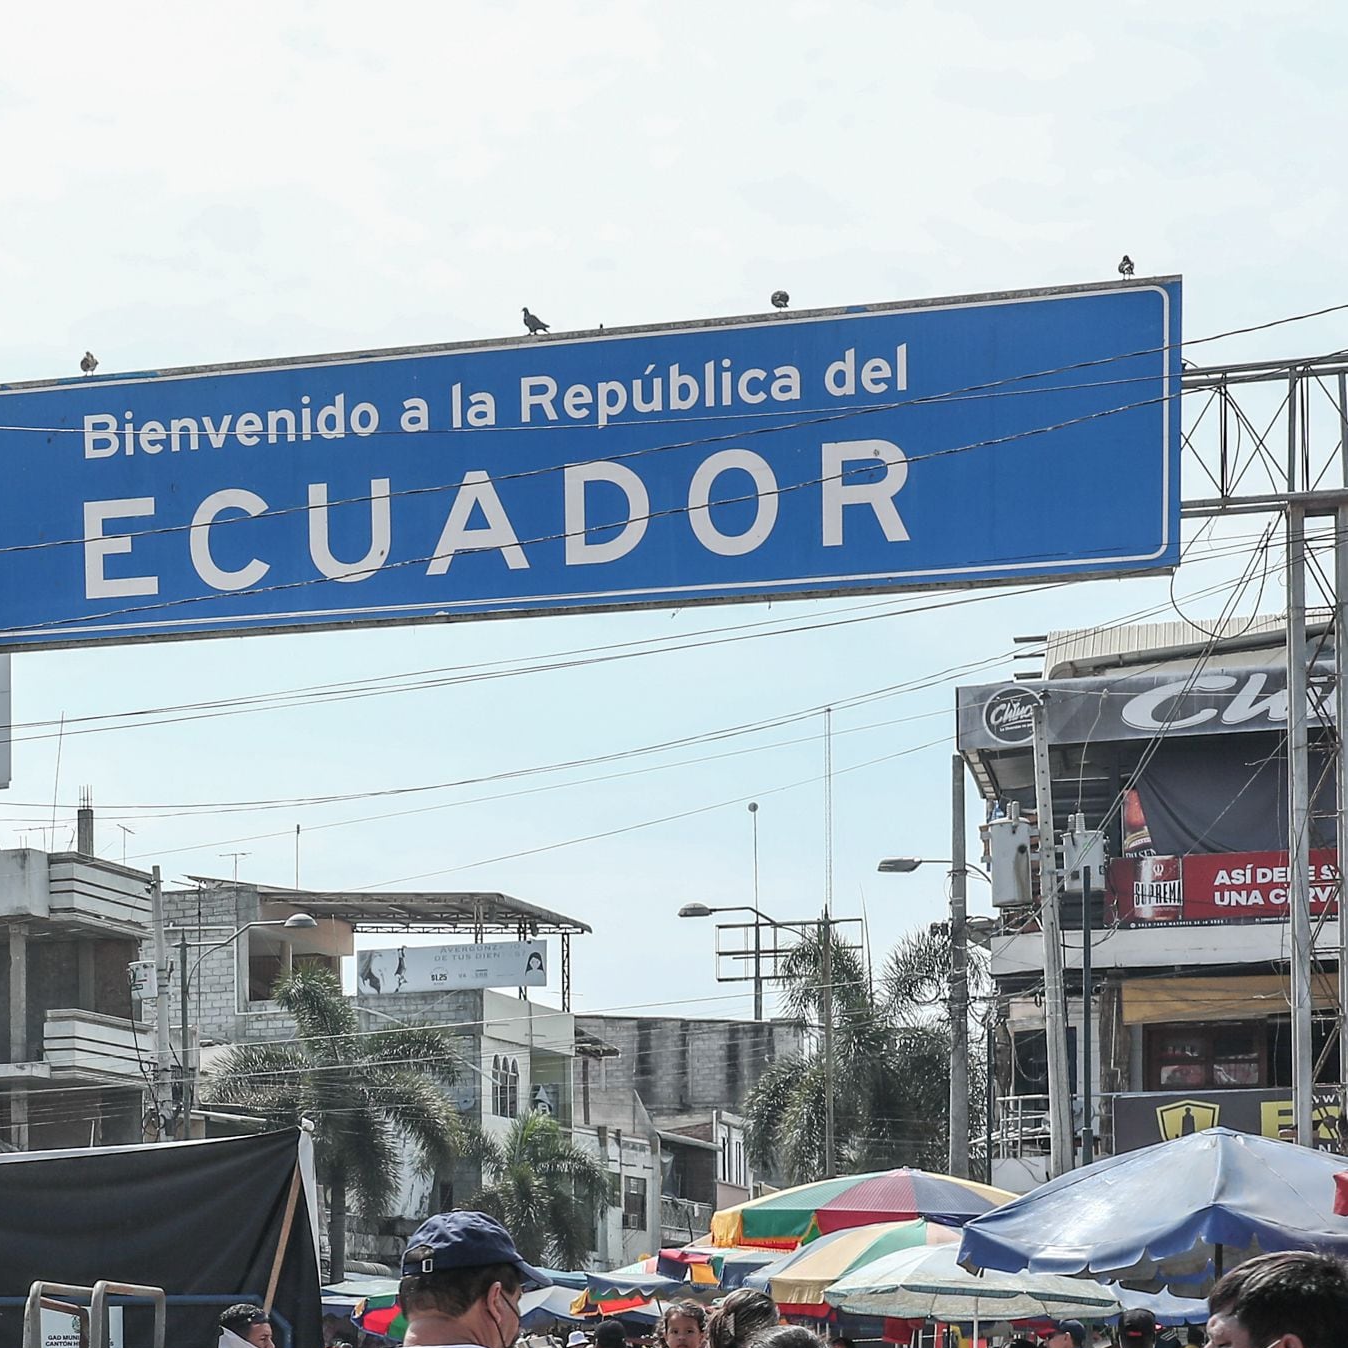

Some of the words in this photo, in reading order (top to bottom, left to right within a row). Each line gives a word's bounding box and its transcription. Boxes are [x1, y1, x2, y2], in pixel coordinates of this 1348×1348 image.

[83, 403, 380, 460] Bienvenido
[400, 399, 431, 433] a
[451, 382, 493, 429] la
[521, 361, 802, 429] República
[824, 344, 908, 394] del
[83, 439, 911, 600] ECUADOR
[1214, 863, 1252, 885] ASÍ
[1256, 866, 1315, 884] DEE
[1214, 888, 1259, 906] UNA
